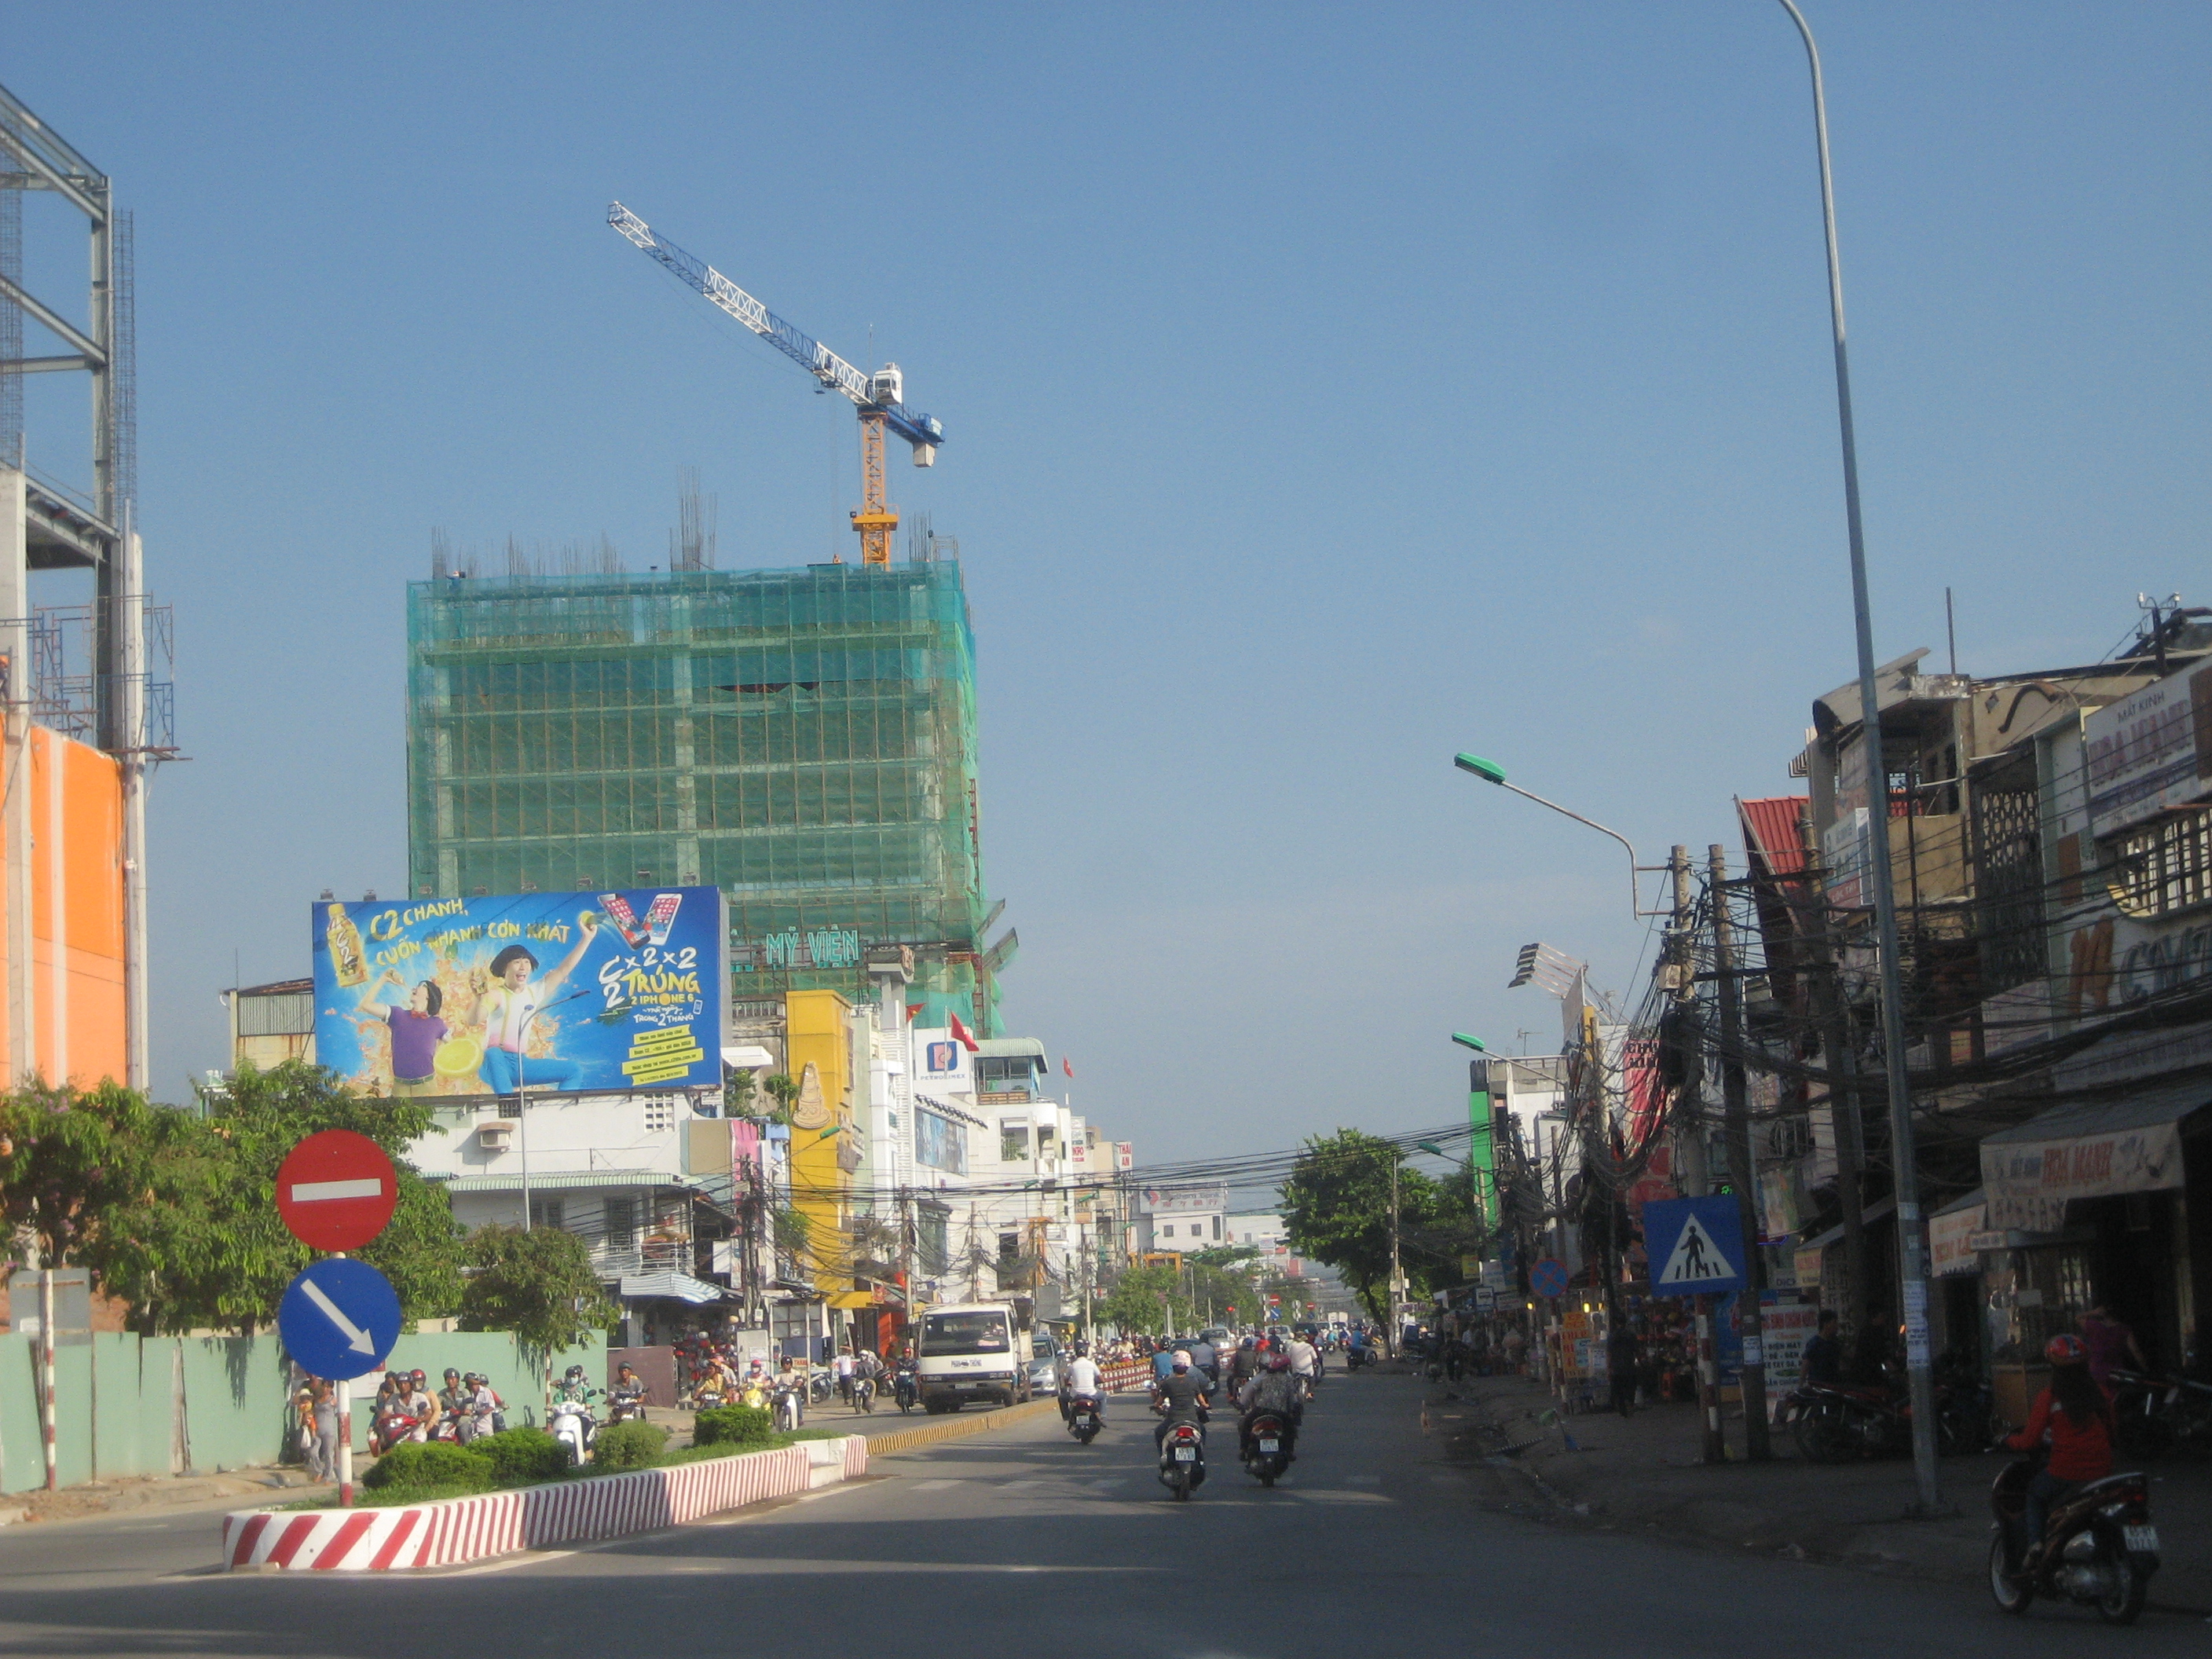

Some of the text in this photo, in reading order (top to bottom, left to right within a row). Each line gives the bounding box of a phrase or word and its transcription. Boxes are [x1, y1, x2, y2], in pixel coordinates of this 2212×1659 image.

[370, 898, 469, 941] C2 CHANH,
[620, 964, 701, 997] TRÚNG
[687, 993, 694, 1002] 6
[657, 1013, 666, 1026] 2
